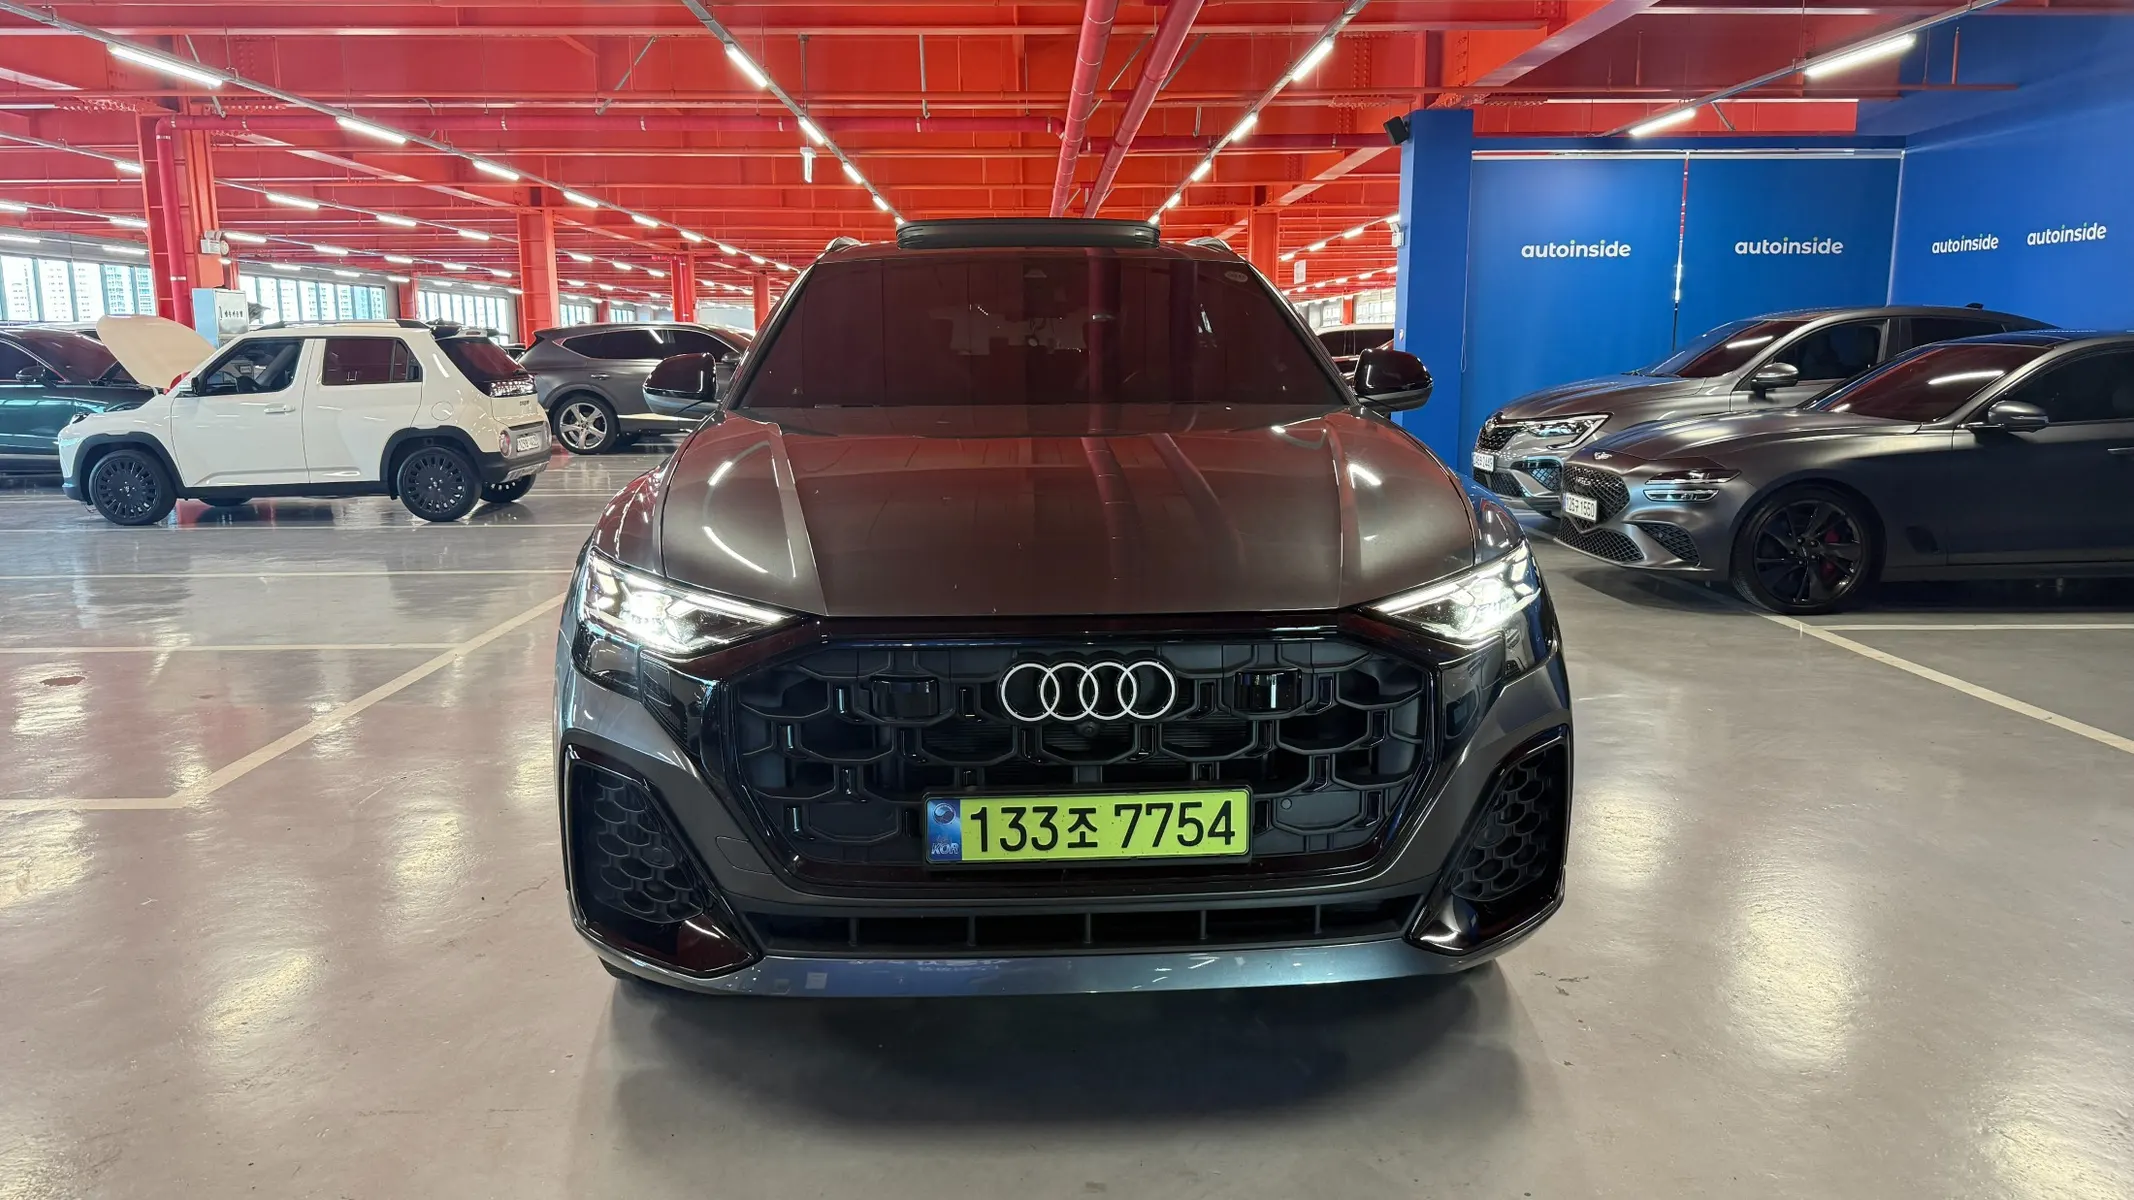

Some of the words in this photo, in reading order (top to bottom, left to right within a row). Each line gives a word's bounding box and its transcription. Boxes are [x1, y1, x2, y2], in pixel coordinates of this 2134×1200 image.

[1932, 233, 1999, 254] autoinside
[2027, 221, 2107, 246] autoinside
[1521, 239, 1632, 258] autoinside
[1734, 236, 1844, 255] autoinside
[970, 805, 1098, 852] 133조
[1114, 800, 1236, 849] 7754
[931, 842, 960, 855] KOR
